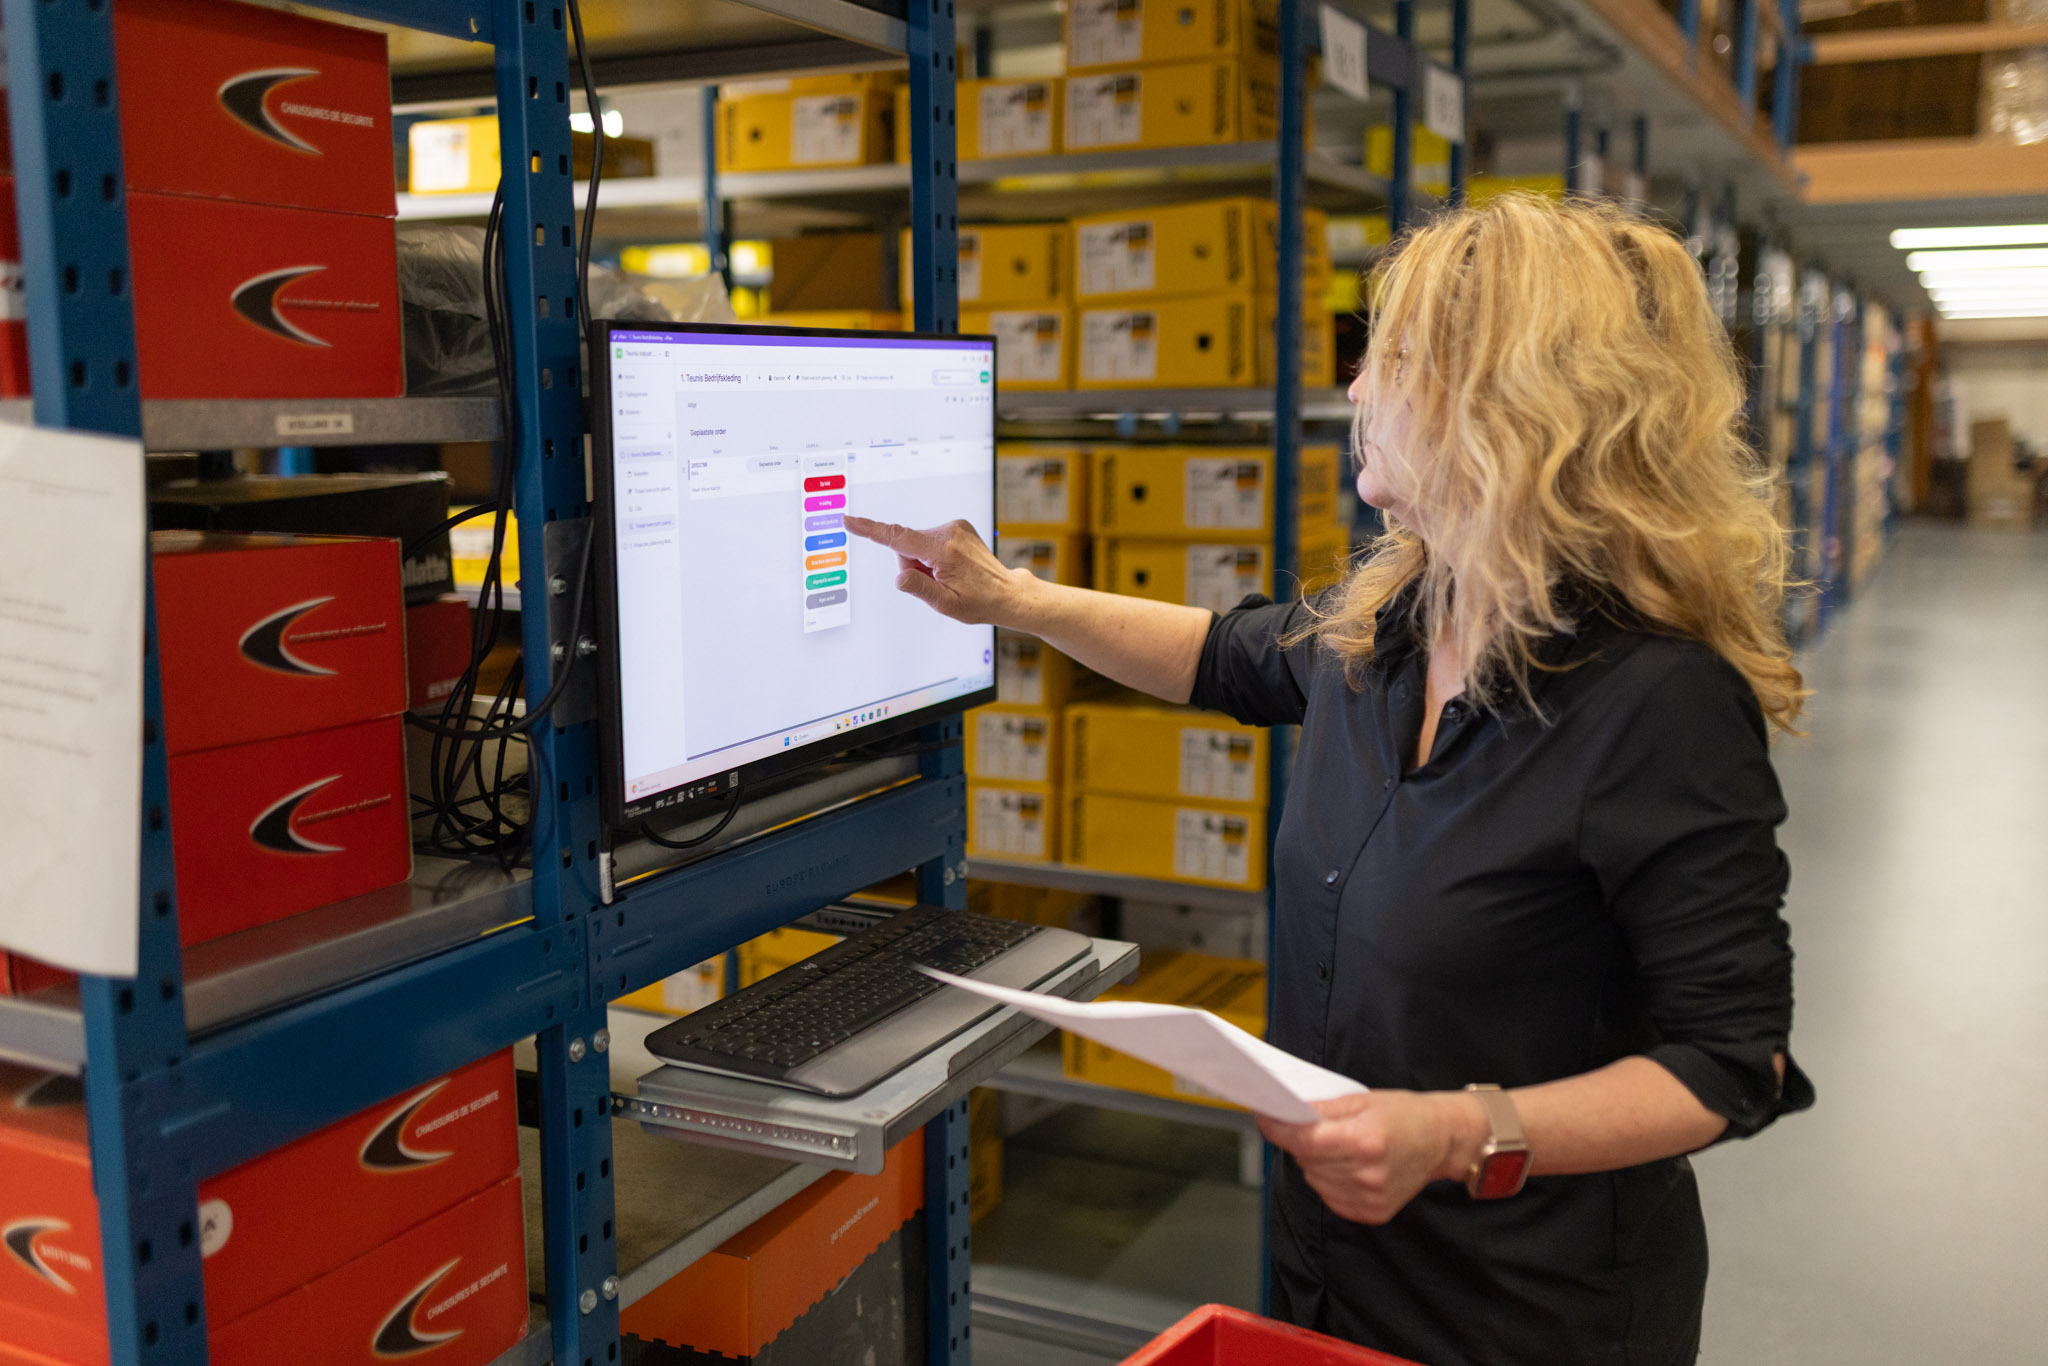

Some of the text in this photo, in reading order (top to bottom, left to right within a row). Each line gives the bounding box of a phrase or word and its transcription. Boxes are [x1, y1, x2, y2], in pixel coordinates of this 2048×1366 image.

[686, 374, 703, 383] Teunis
[704, 373, 742, 384] Bedrijfskleding
[714, 428, 727, 436] order
